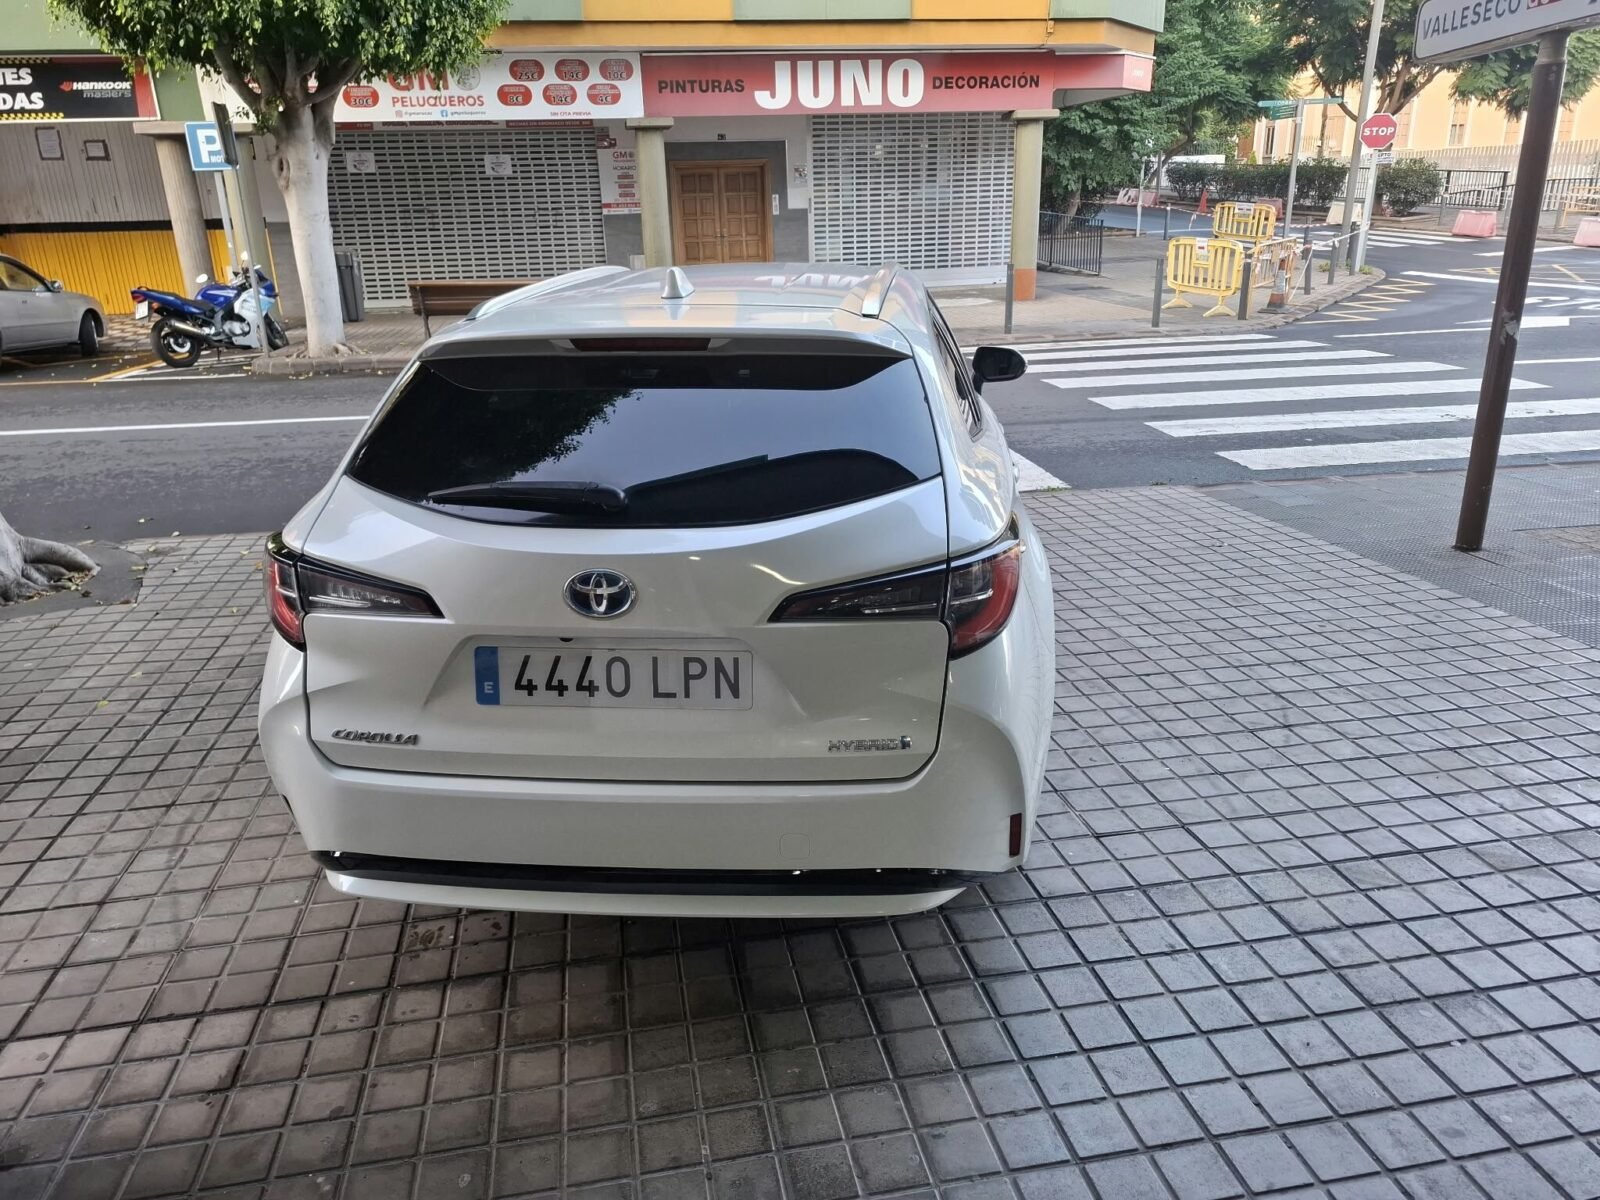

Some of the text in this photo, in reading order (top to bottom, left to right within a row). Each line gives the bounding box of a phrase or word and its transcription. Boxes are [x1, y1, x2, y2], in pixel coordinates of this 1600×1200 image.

[1422, 0, 1521, 40] VALLESECO
[657, 79, 745, 94] PINTURAS
[754, 58, 925, 110] JUNO
[932, 72, 1040, 90] DECORACIÓN
[391, 95, 485, 108] PELUQUEROS
[1363, 127, 1395, 136] STOP
[196, 129, 222, 163] P
[514, 654, 740, 699] 4440 LPN
[483, 681, 494, 694] E
[331, 729, 420, 746] COROLLA
[828, 739, 899, 752] HYBRID
